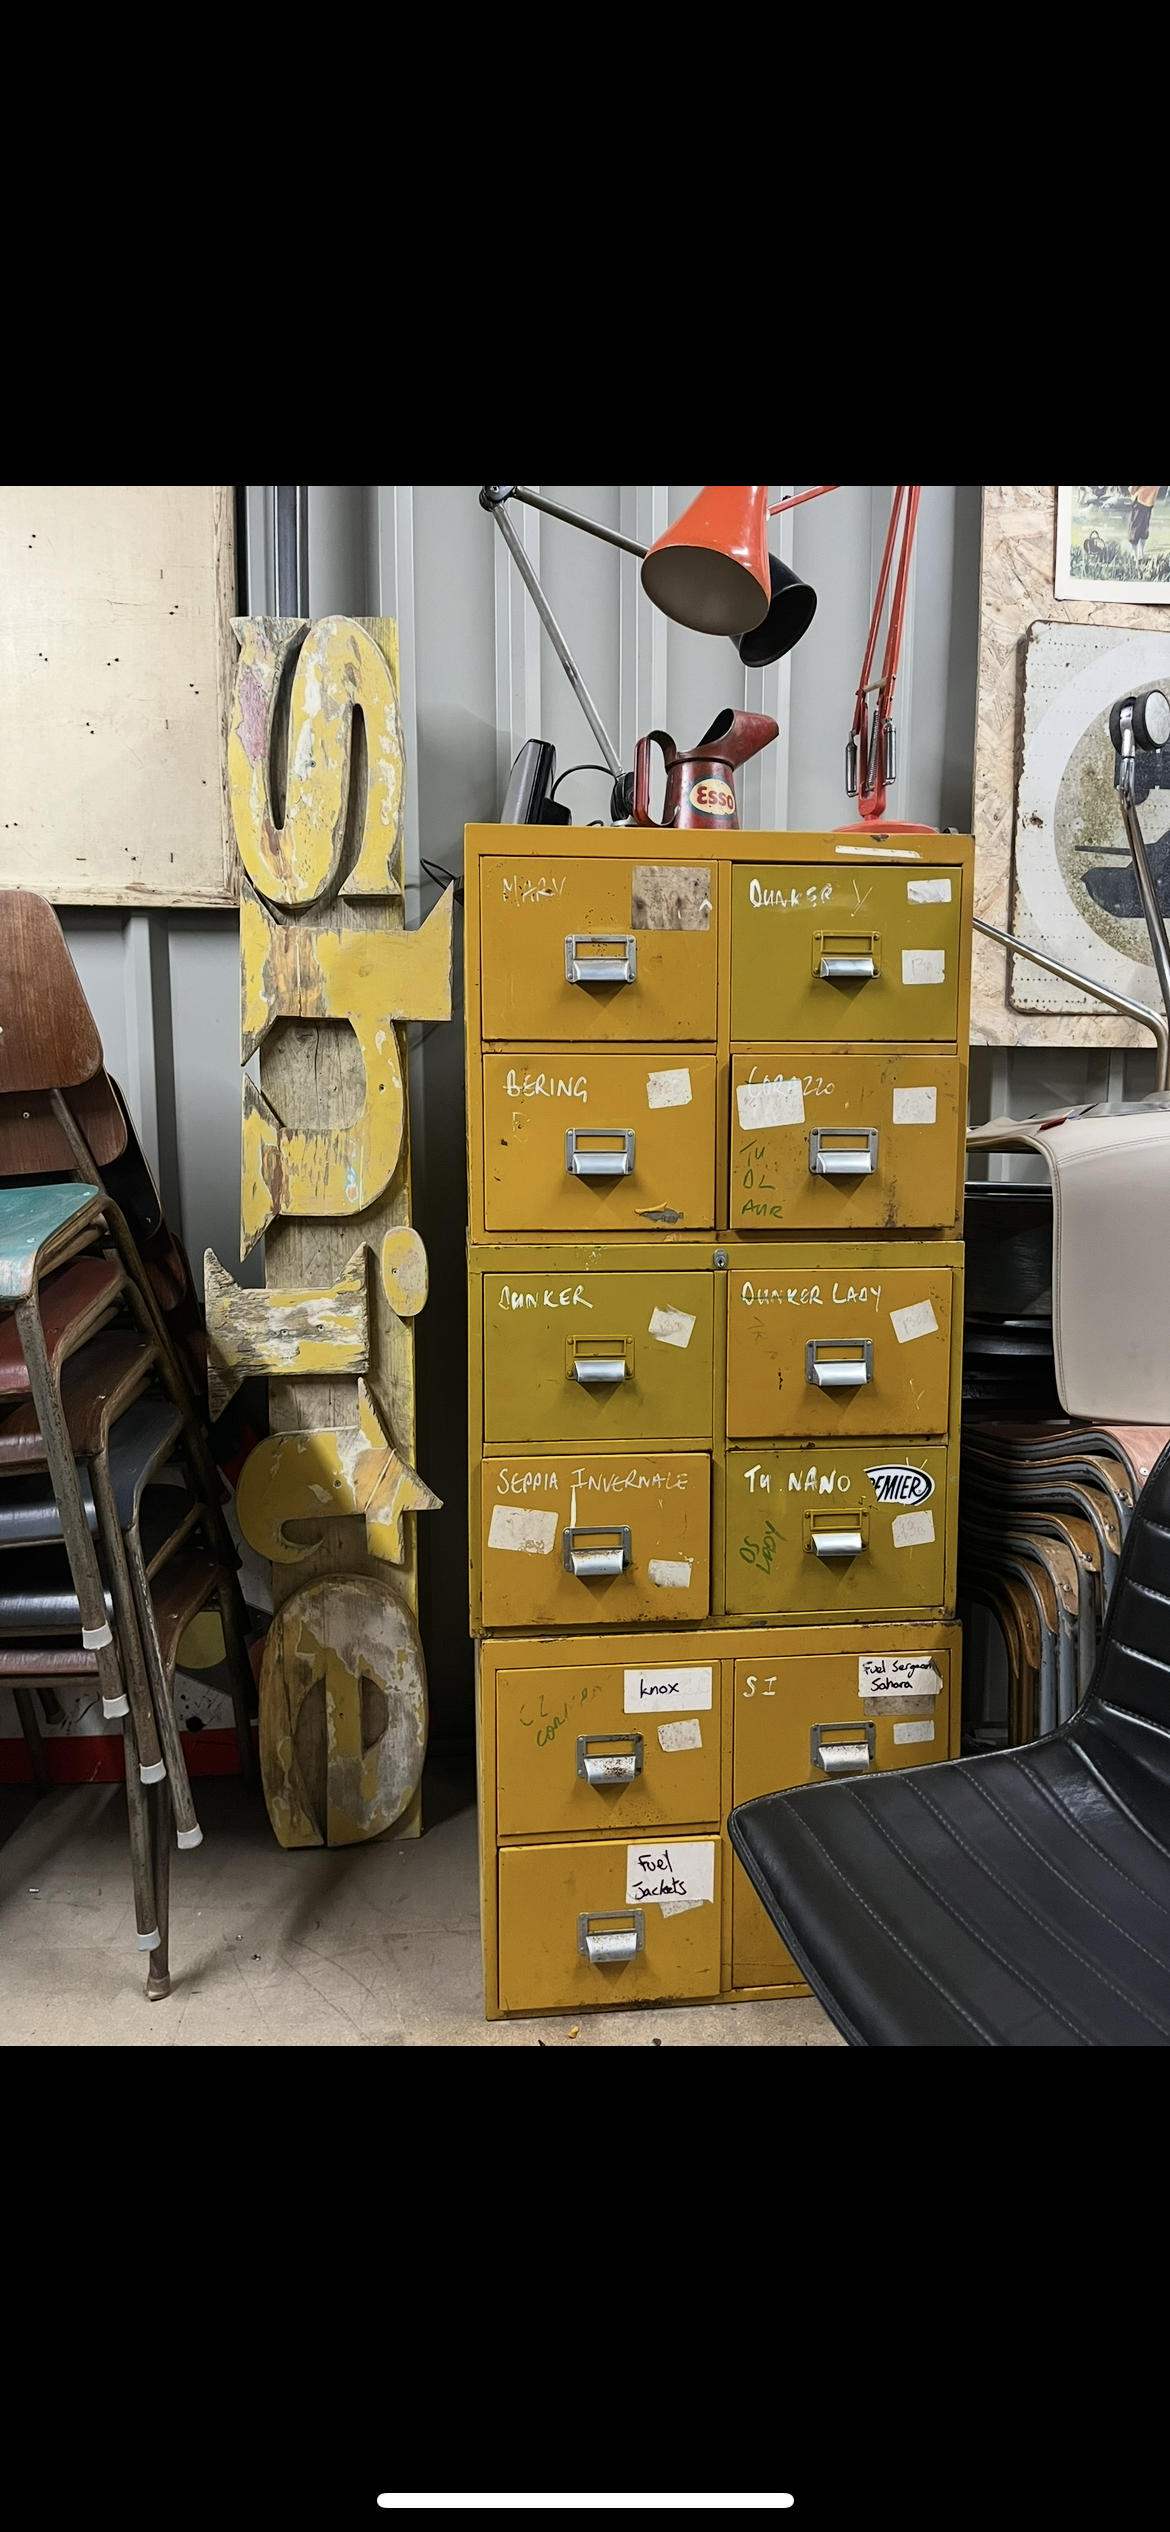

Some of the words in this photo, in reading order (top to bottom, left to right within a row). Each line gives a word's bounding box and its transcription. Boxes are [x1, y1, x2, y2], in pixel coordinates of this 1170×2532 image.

[503, 1069, 588, 1103] BERING
[740, 1281, 824, 1306] DUNKER
[831, 1282, 882, 1313] LADY
[496, 1467, 559, 1494] SEPPIA
[788, 1466, 851, 1495] NANO
[862, 1659, 886, 1676] Fuel
[640, 1679, 680, 1699] knox
[870, 1677, 913, 1692] Sahara
[637, 1849, 673, 1873] Fuel
[632, 1876, 687, 1901] Jackets
